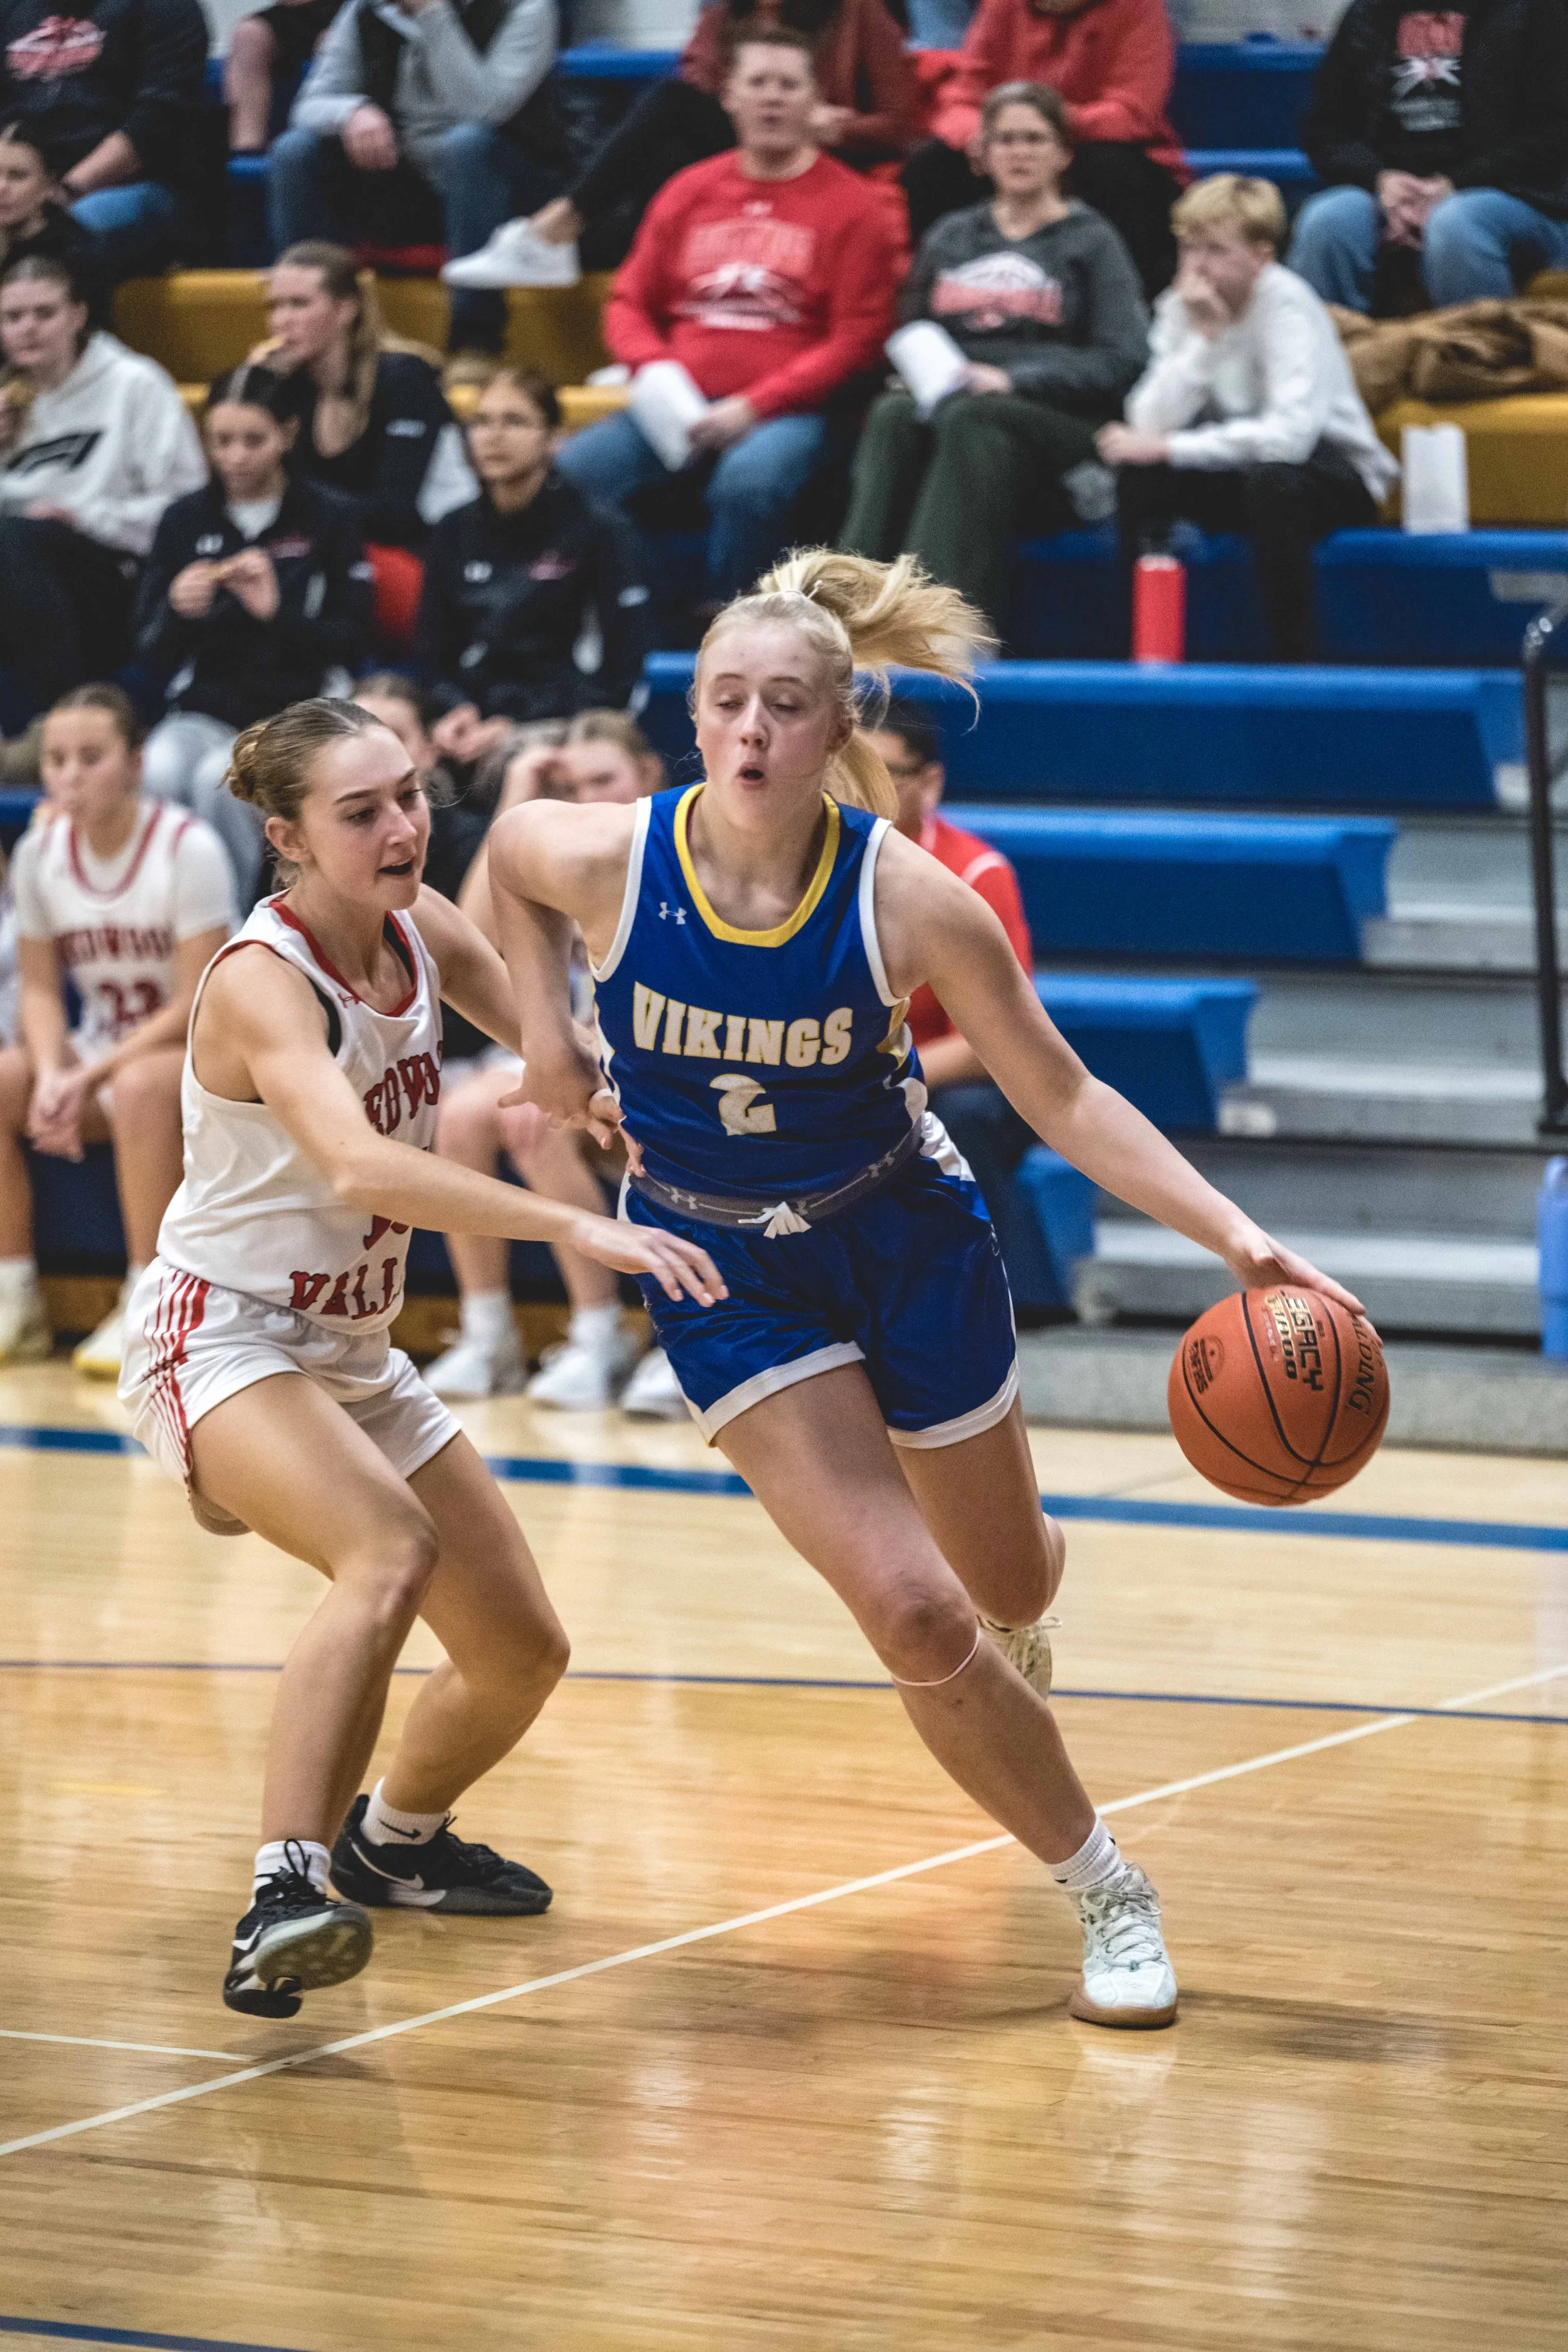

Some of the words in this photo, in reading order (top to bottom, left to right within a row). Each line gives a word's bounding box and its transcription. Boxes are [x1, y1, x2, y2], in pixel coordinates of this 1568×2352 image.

[632, 981, 854, 1067] VIKINGS
[709, 1073, 776, 1136] 2
[289, 1257, 401, 1320] VALL
